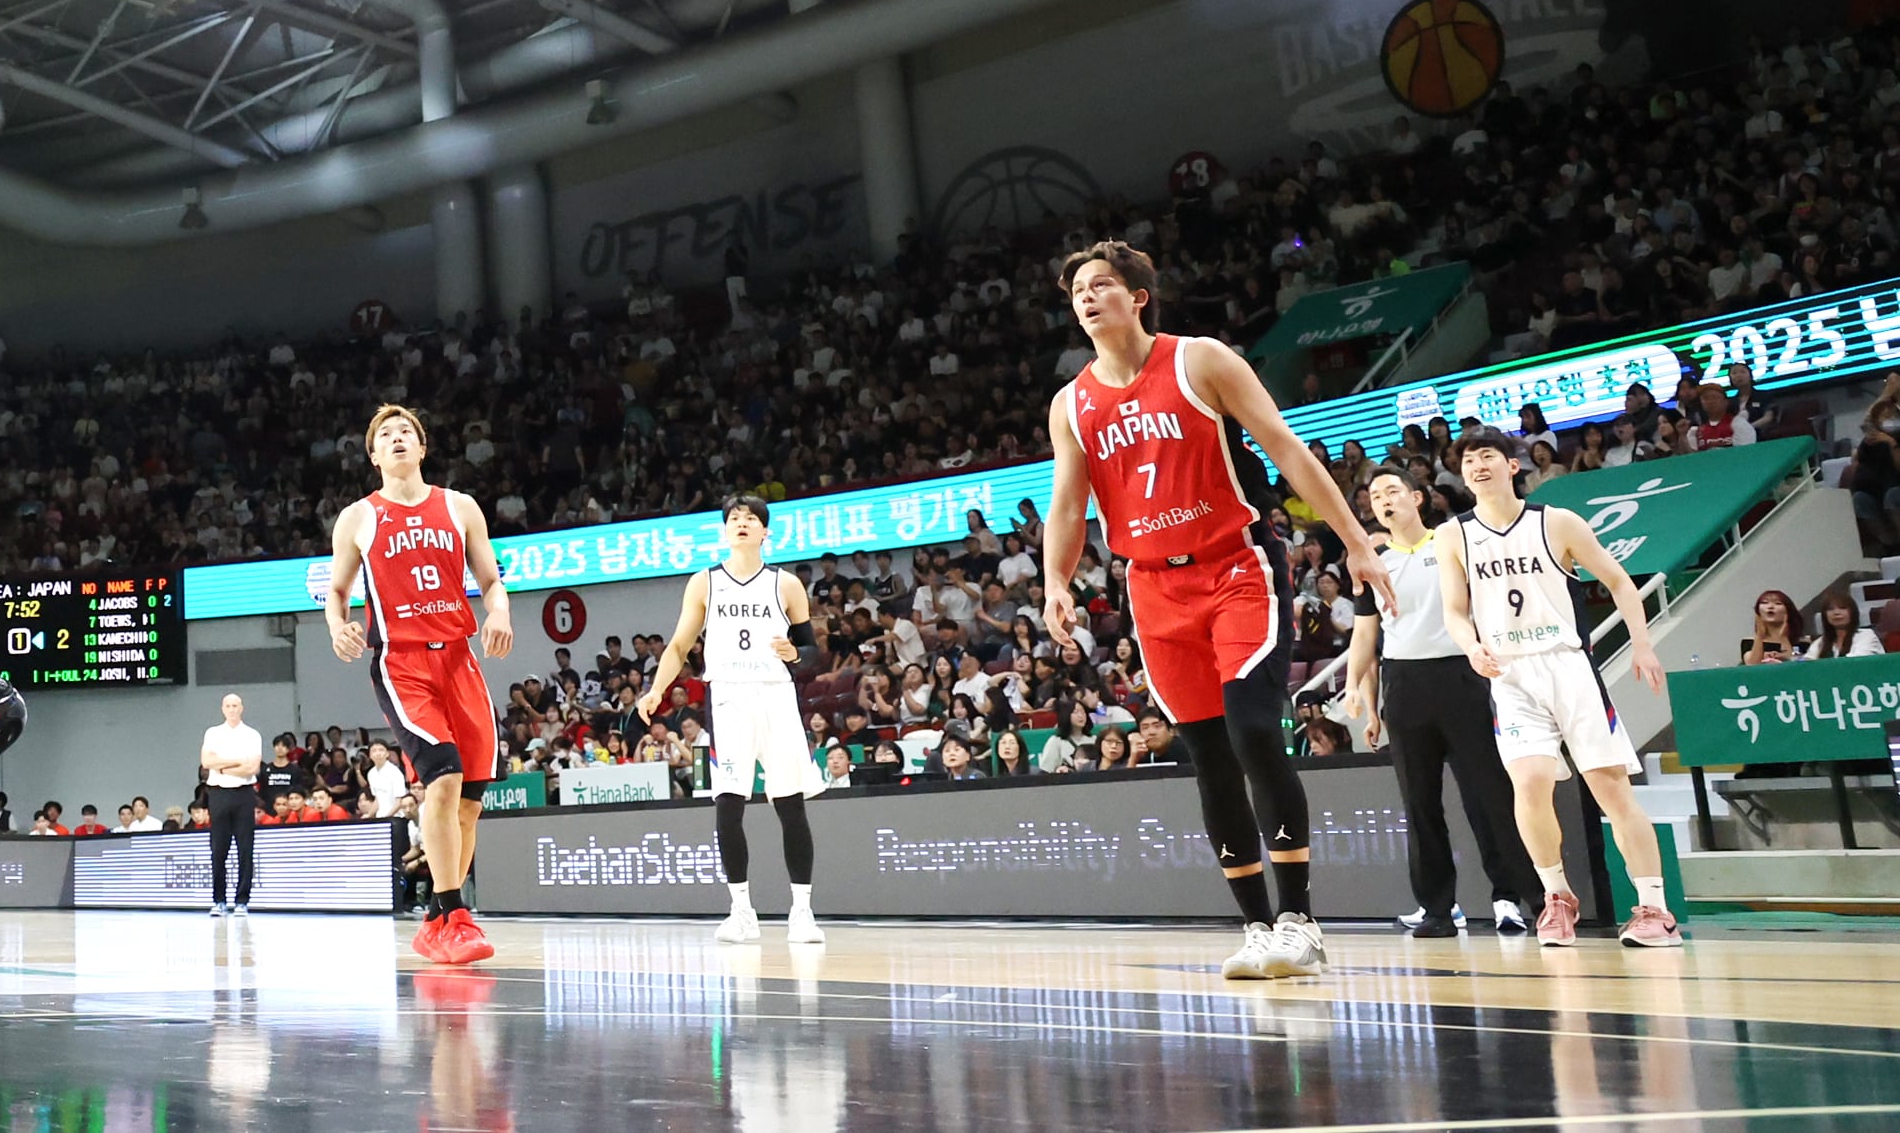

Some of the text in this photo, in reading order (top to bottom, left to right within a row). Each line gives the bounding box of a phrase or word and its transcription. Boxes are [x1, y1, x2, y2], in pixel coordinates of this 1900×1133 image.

[1175, 159, 1209, 186] 18
[581, 173, 863, 278] OFFENSE
[357, 306, 383, 328] 17
[1690, 307, 1846, 387] 2025
[1096, 412, 1183, 460] JAPAN
[1137, 462, 1156, 498] 7
[1141, 499, 1213, 534] SoftBank
[384, 528, 454, 558] JAPAN
[502, 482, 995, 583] 2025 남자농구 가대표 평가전
[410, 565, 440, 591] 19
[1476, 557, 1544, 580] KOREA
[27, 581, 71, 597] JAPAN
[82, 579, 166, 594] NO NAME F P
[4, 601, 40, 618] 7:52
[89, 595, 171, 610] 4 JACOBS 0 2
[413, 600, 462, 616] SoftBank
[717, 604, 771, 618] KOREA
[1508, 589, 1524, 616] 9
[89, 617, 96, 628] 7
[553, 599, 573, 633] 6
[15, 634, 22, 649] 1
[57, 629, 69, 649] 2
[84, 635, 96, 646] 13
[149, 631, 156, 642] 0
[739, 629, 750, 650] 8
[1508, 625, 1560, 643] 하나은행
[84, 649, 157, 663] 19 NISHIDA 0
[83, 670, 97, 681] 24
[149, 667, 157, 677] 0
[590, 782, 655, 803] Hana Bank
